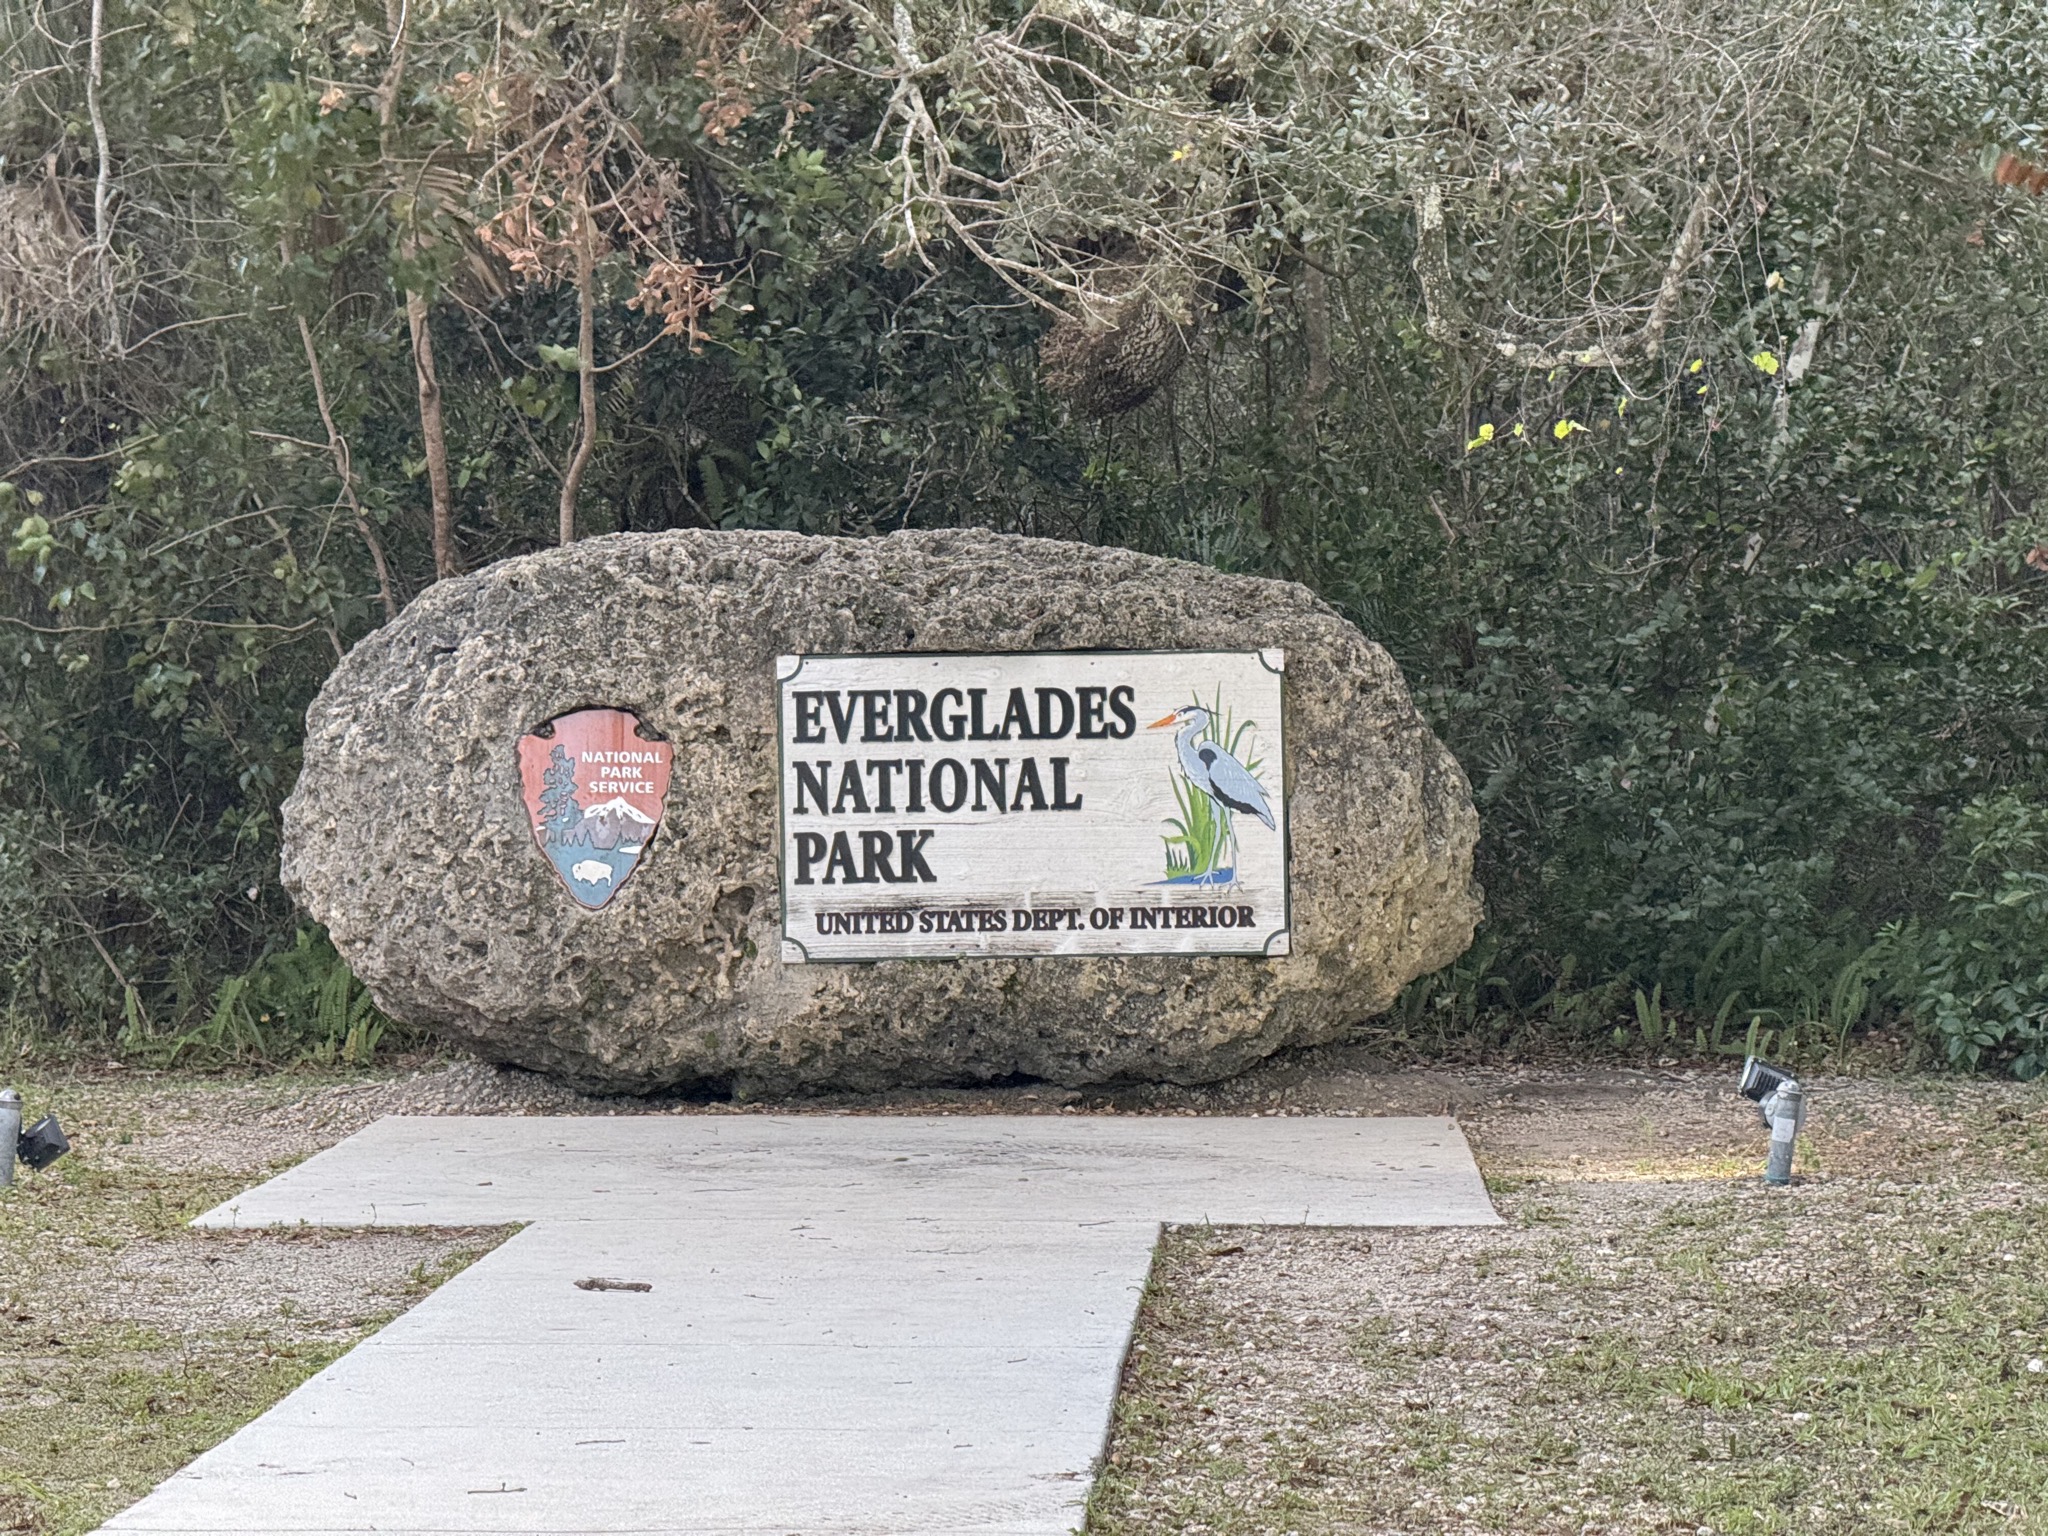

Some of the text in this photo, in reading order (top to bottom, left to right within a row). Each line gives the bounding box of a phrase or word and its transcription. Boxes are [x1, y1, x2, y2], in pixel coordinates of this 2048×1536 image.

[792, 686, 1137, 744] EVERGLADES
[581, 751, 663, 764] NATIONAL
[589, 781, 654, 794] SERVICE
[601, 767, 642, 779] PARK
[793, 757, 1083, 816] NATIONAL
[794, 829, 937, 885] PARK
[816, 906, 1256, 936] UNITED STATES DEPT. OF INTERIOR
